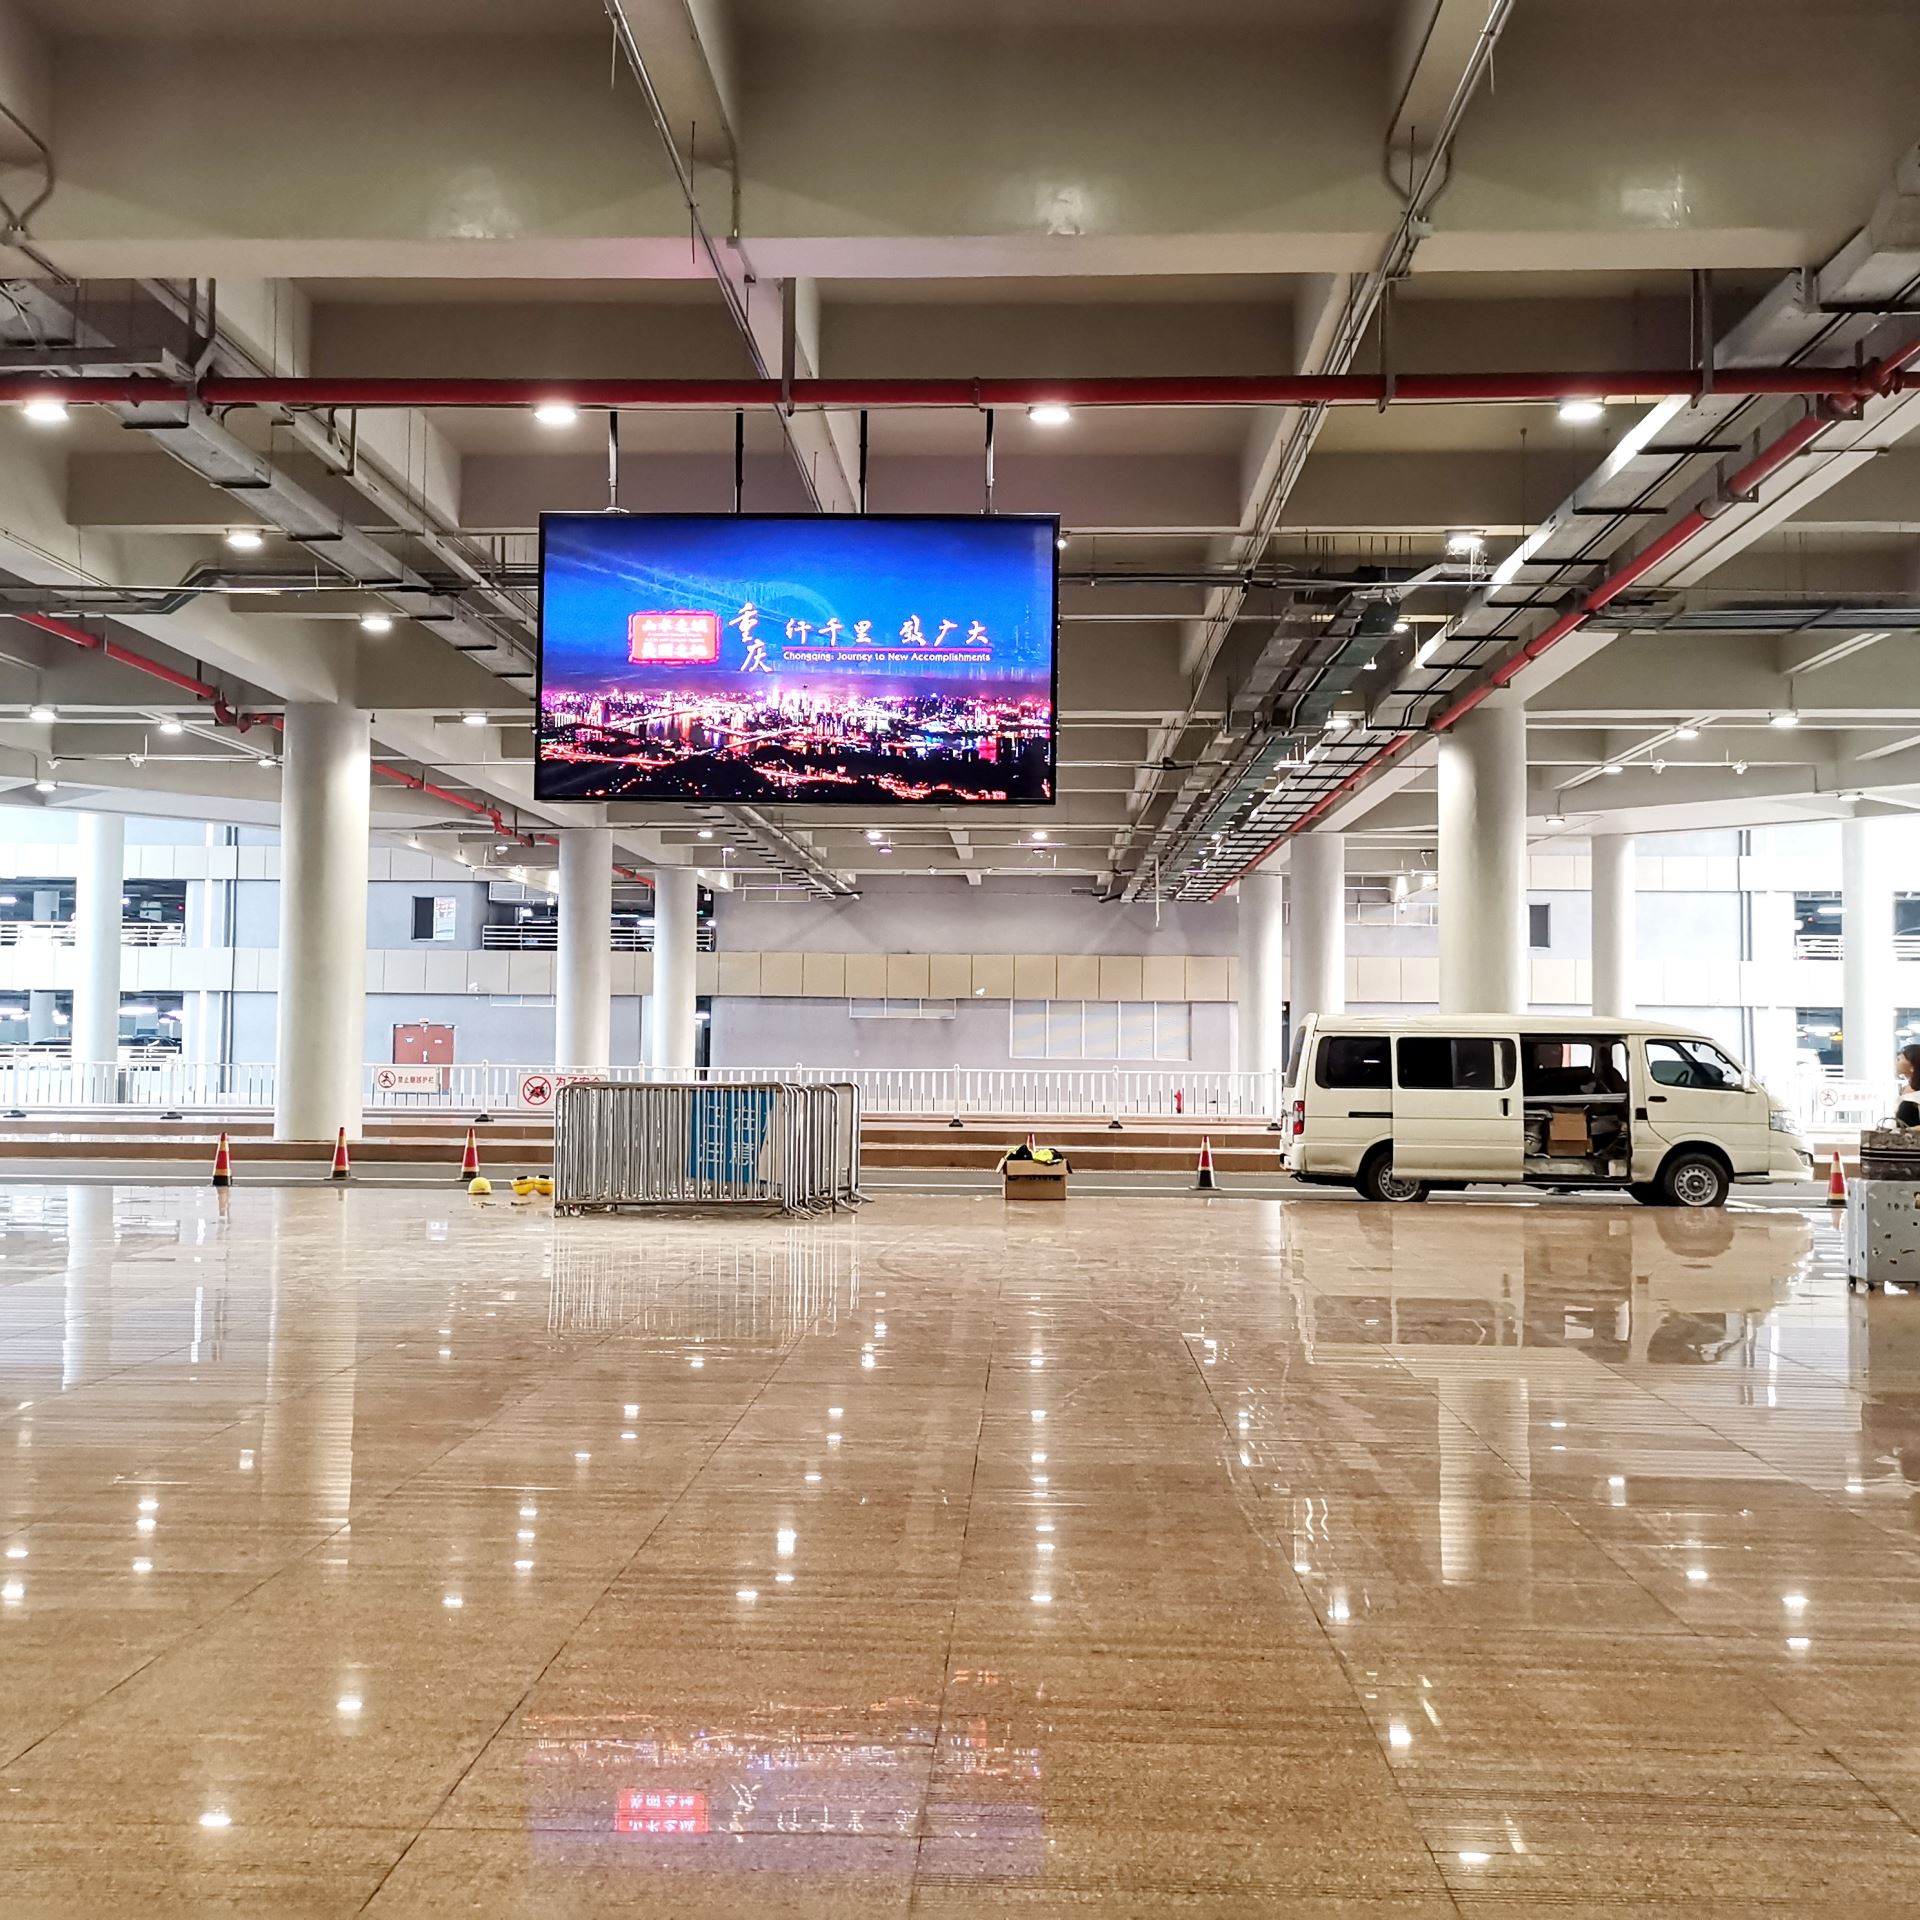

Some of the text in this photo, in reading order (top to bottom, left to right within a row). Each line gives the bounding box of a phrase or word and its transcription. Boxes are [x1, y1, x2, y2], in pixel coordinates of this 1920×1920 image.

[728, 602, 774, 673] 重庆
[899, 614, 989, 647] 致广大
[783, 651, 991, 663] Chongqing: Journey to New Accomplishments
